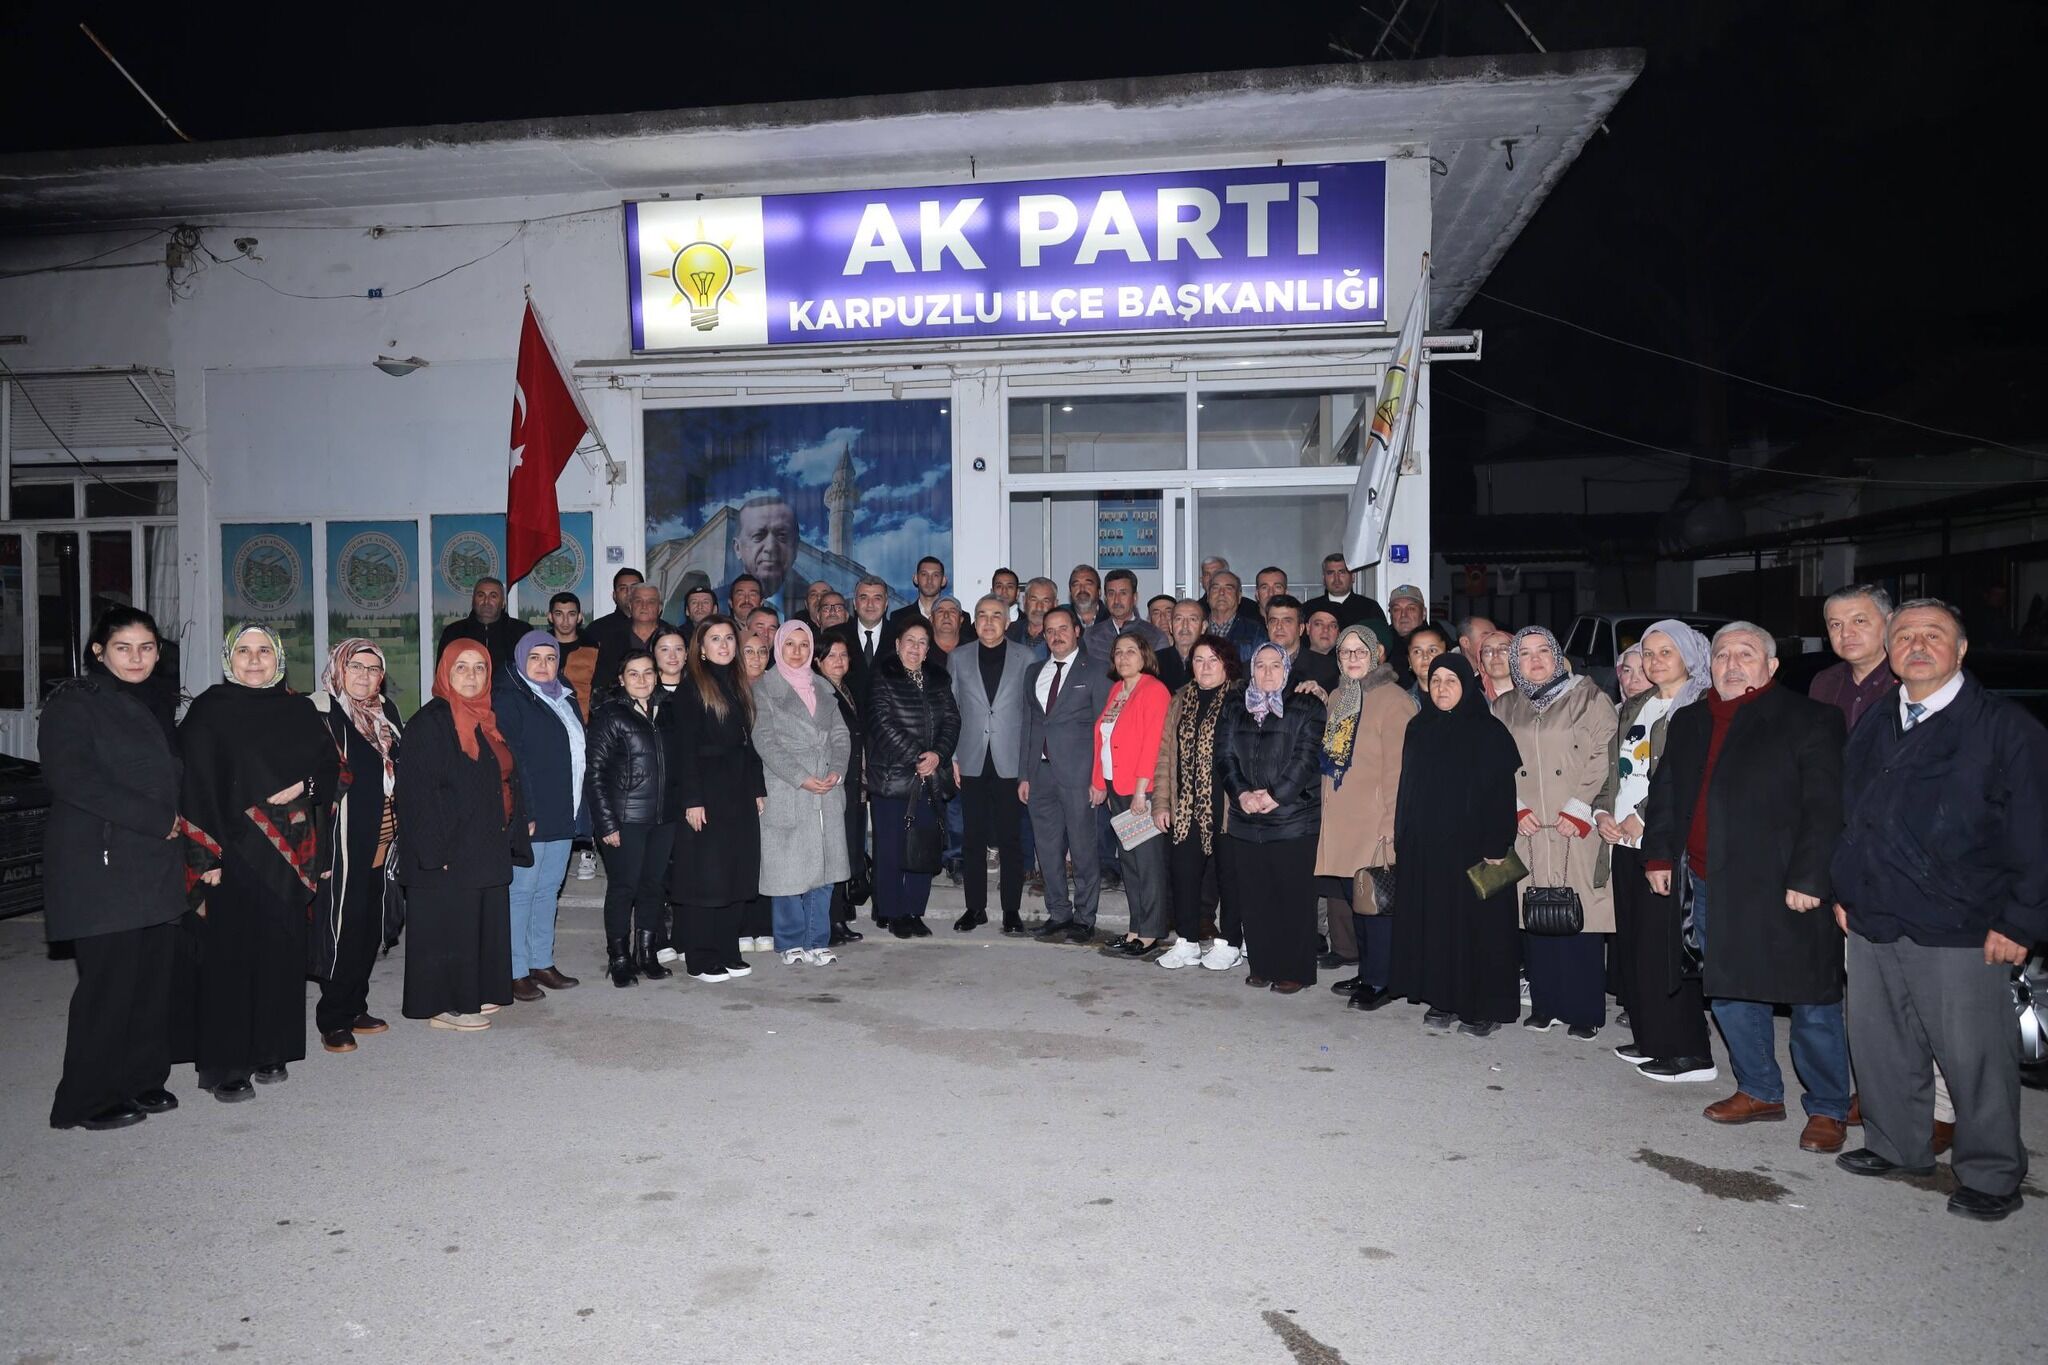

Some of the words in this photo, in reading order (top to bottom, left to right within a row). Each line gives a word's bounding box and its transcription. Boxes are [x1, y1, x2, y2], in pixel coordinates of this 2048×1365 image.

[842, 197, 987, 275] AK
[1019, 181, 1319, 267] PARTİ
[789, 291, 1001, 331] KARPUZLU
[1118, 268, 1378, 321] BAŞKANLIĞI
